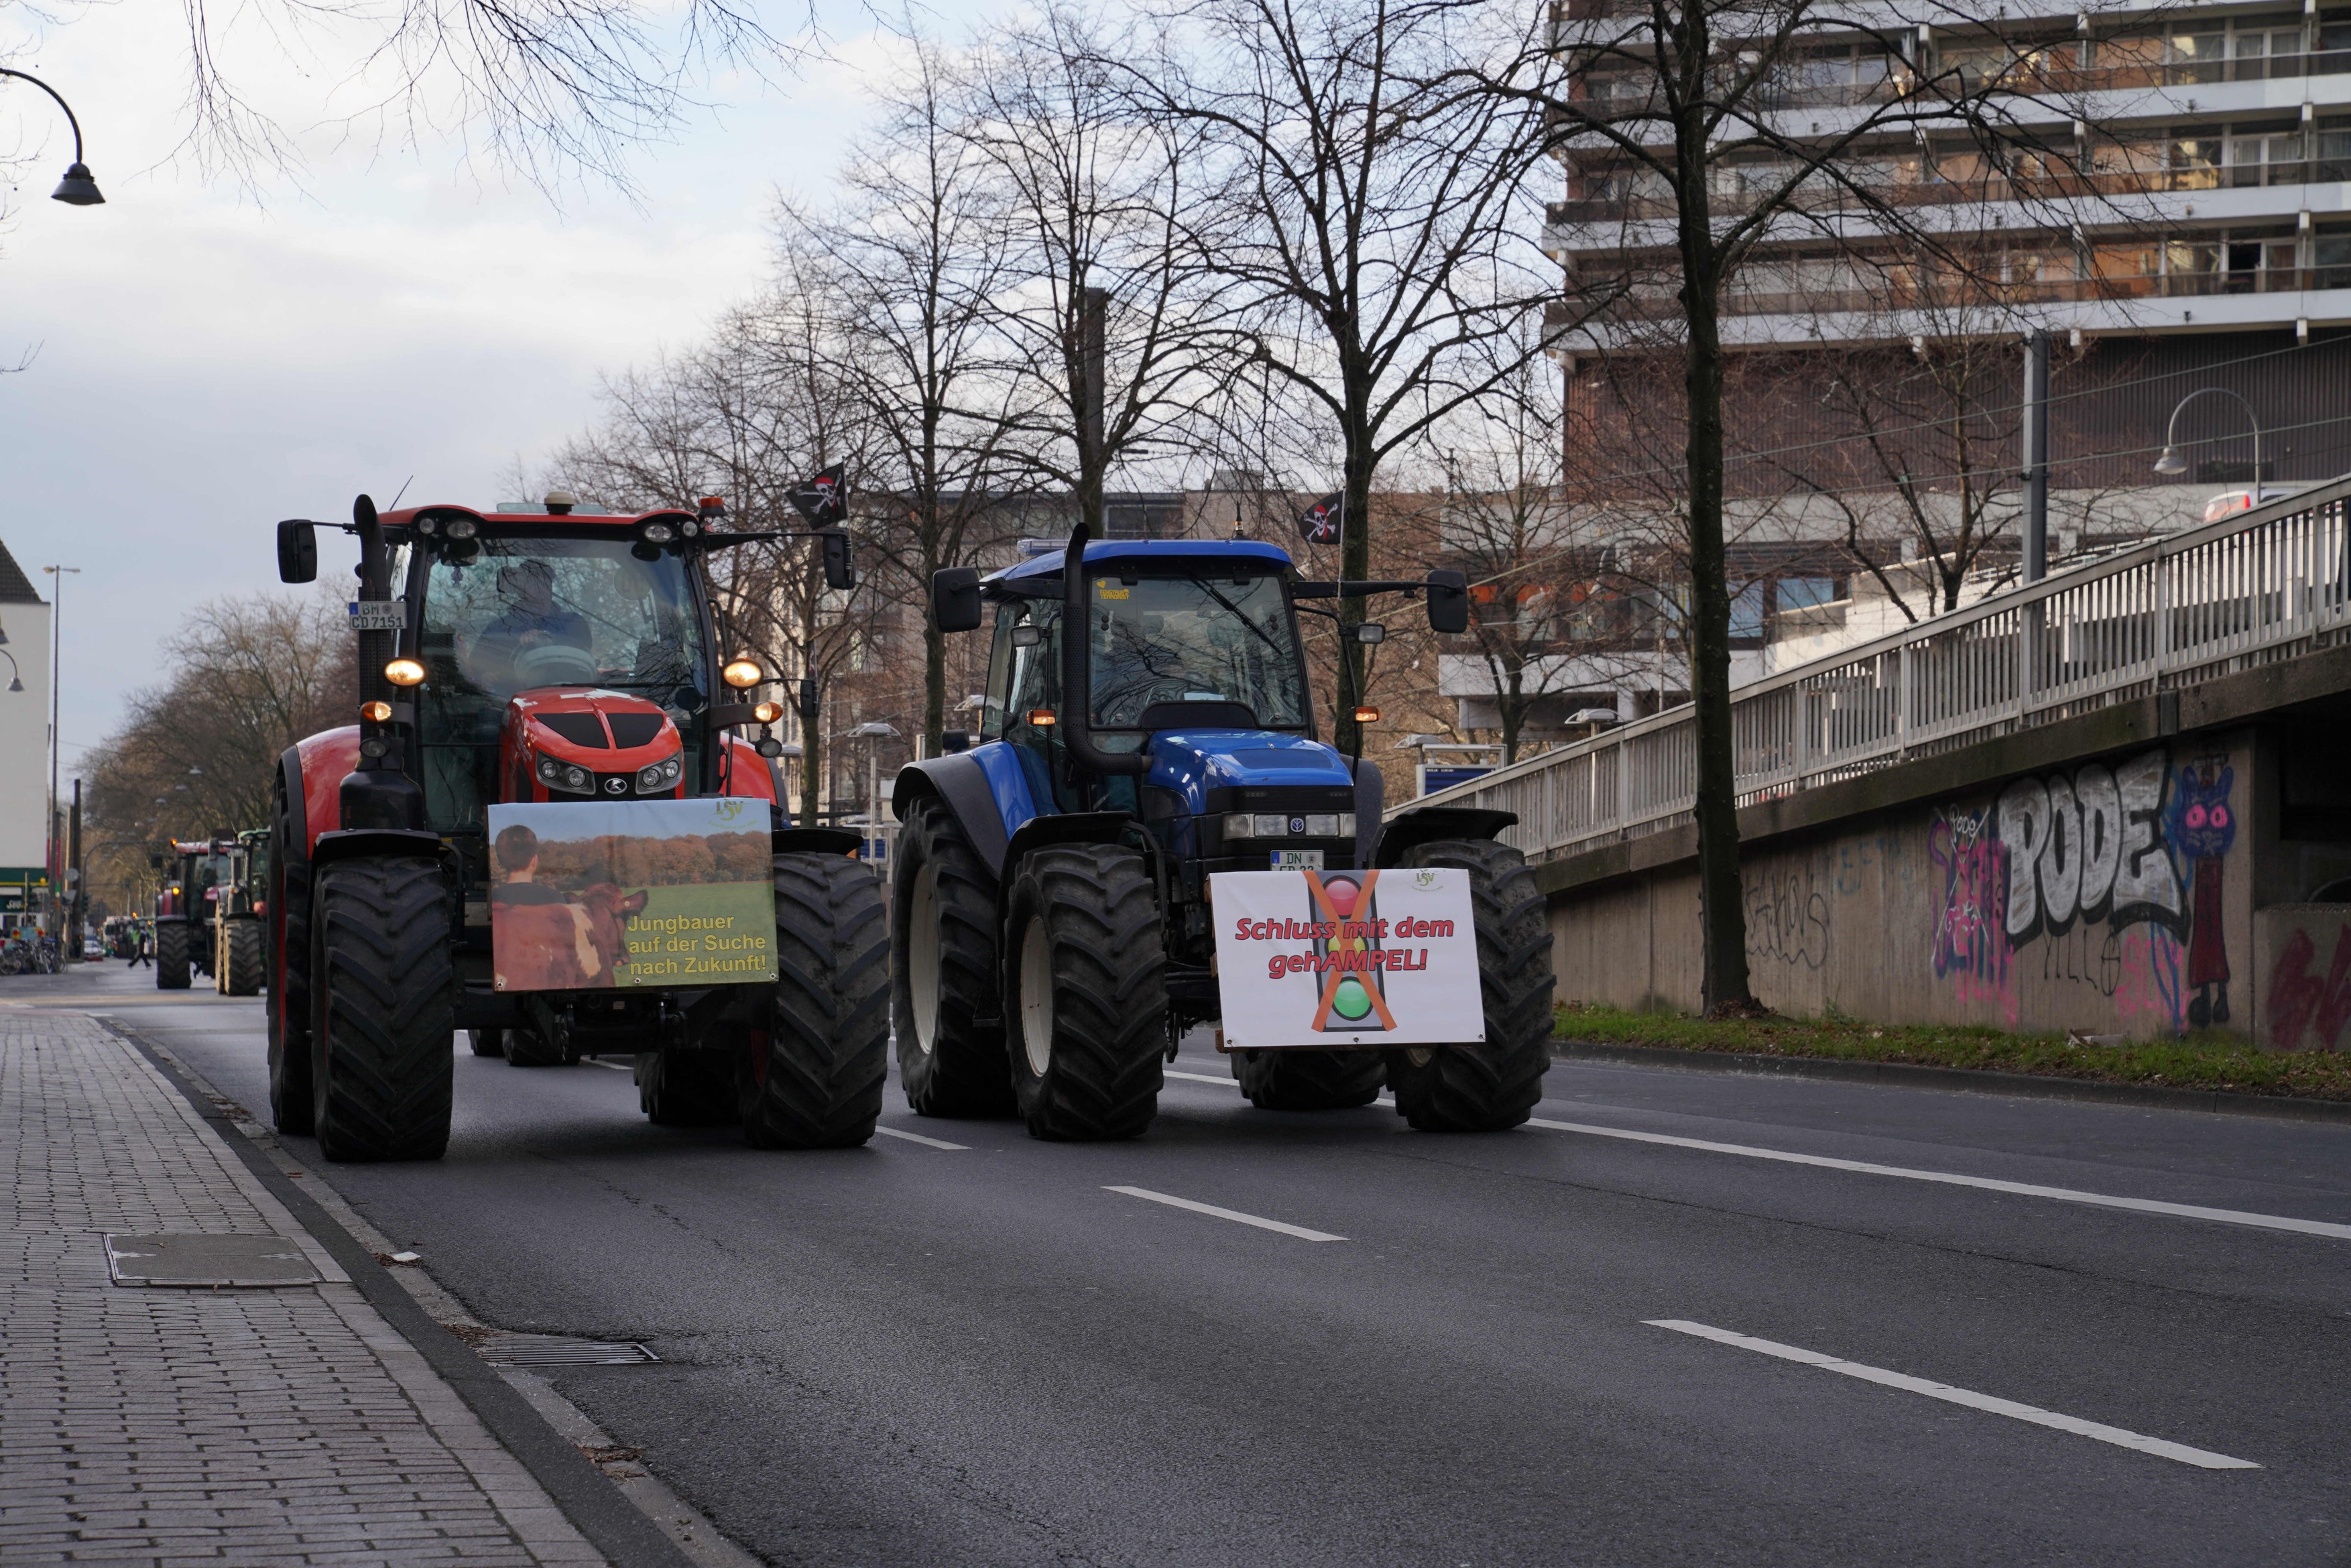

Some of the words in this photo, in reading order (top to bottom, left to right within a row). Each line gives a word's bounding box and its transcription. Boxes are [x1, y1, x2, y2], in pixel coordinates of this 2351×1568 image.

[363, 604, 379, 615] BM
[352, 617, 368, 628] CD
[371, 617, 404, 628] 7151
[716, 800, 744, 821] LSV
[1996, 745, 2188, 944] PODE
[1286, 853, 1302, 863] DN
[1416, 872, 1435, 886] LSV
[627, 914, 735, 934] Jungbauer
[1235, 918, 1336, 940] Schluss
[1343, 917, 1389, 939] mit
[1395, 916, 1454, 938] dem
[629, 936, 661, 954] auf
[666, 936, 699, 953] der
[705, 933, 766, 952] Suche
[629, 957, 678, 975] nach
[684, 954, 766, 973] Zukunft!
[1268, 949, 1429, 979] gehAMPEL!
